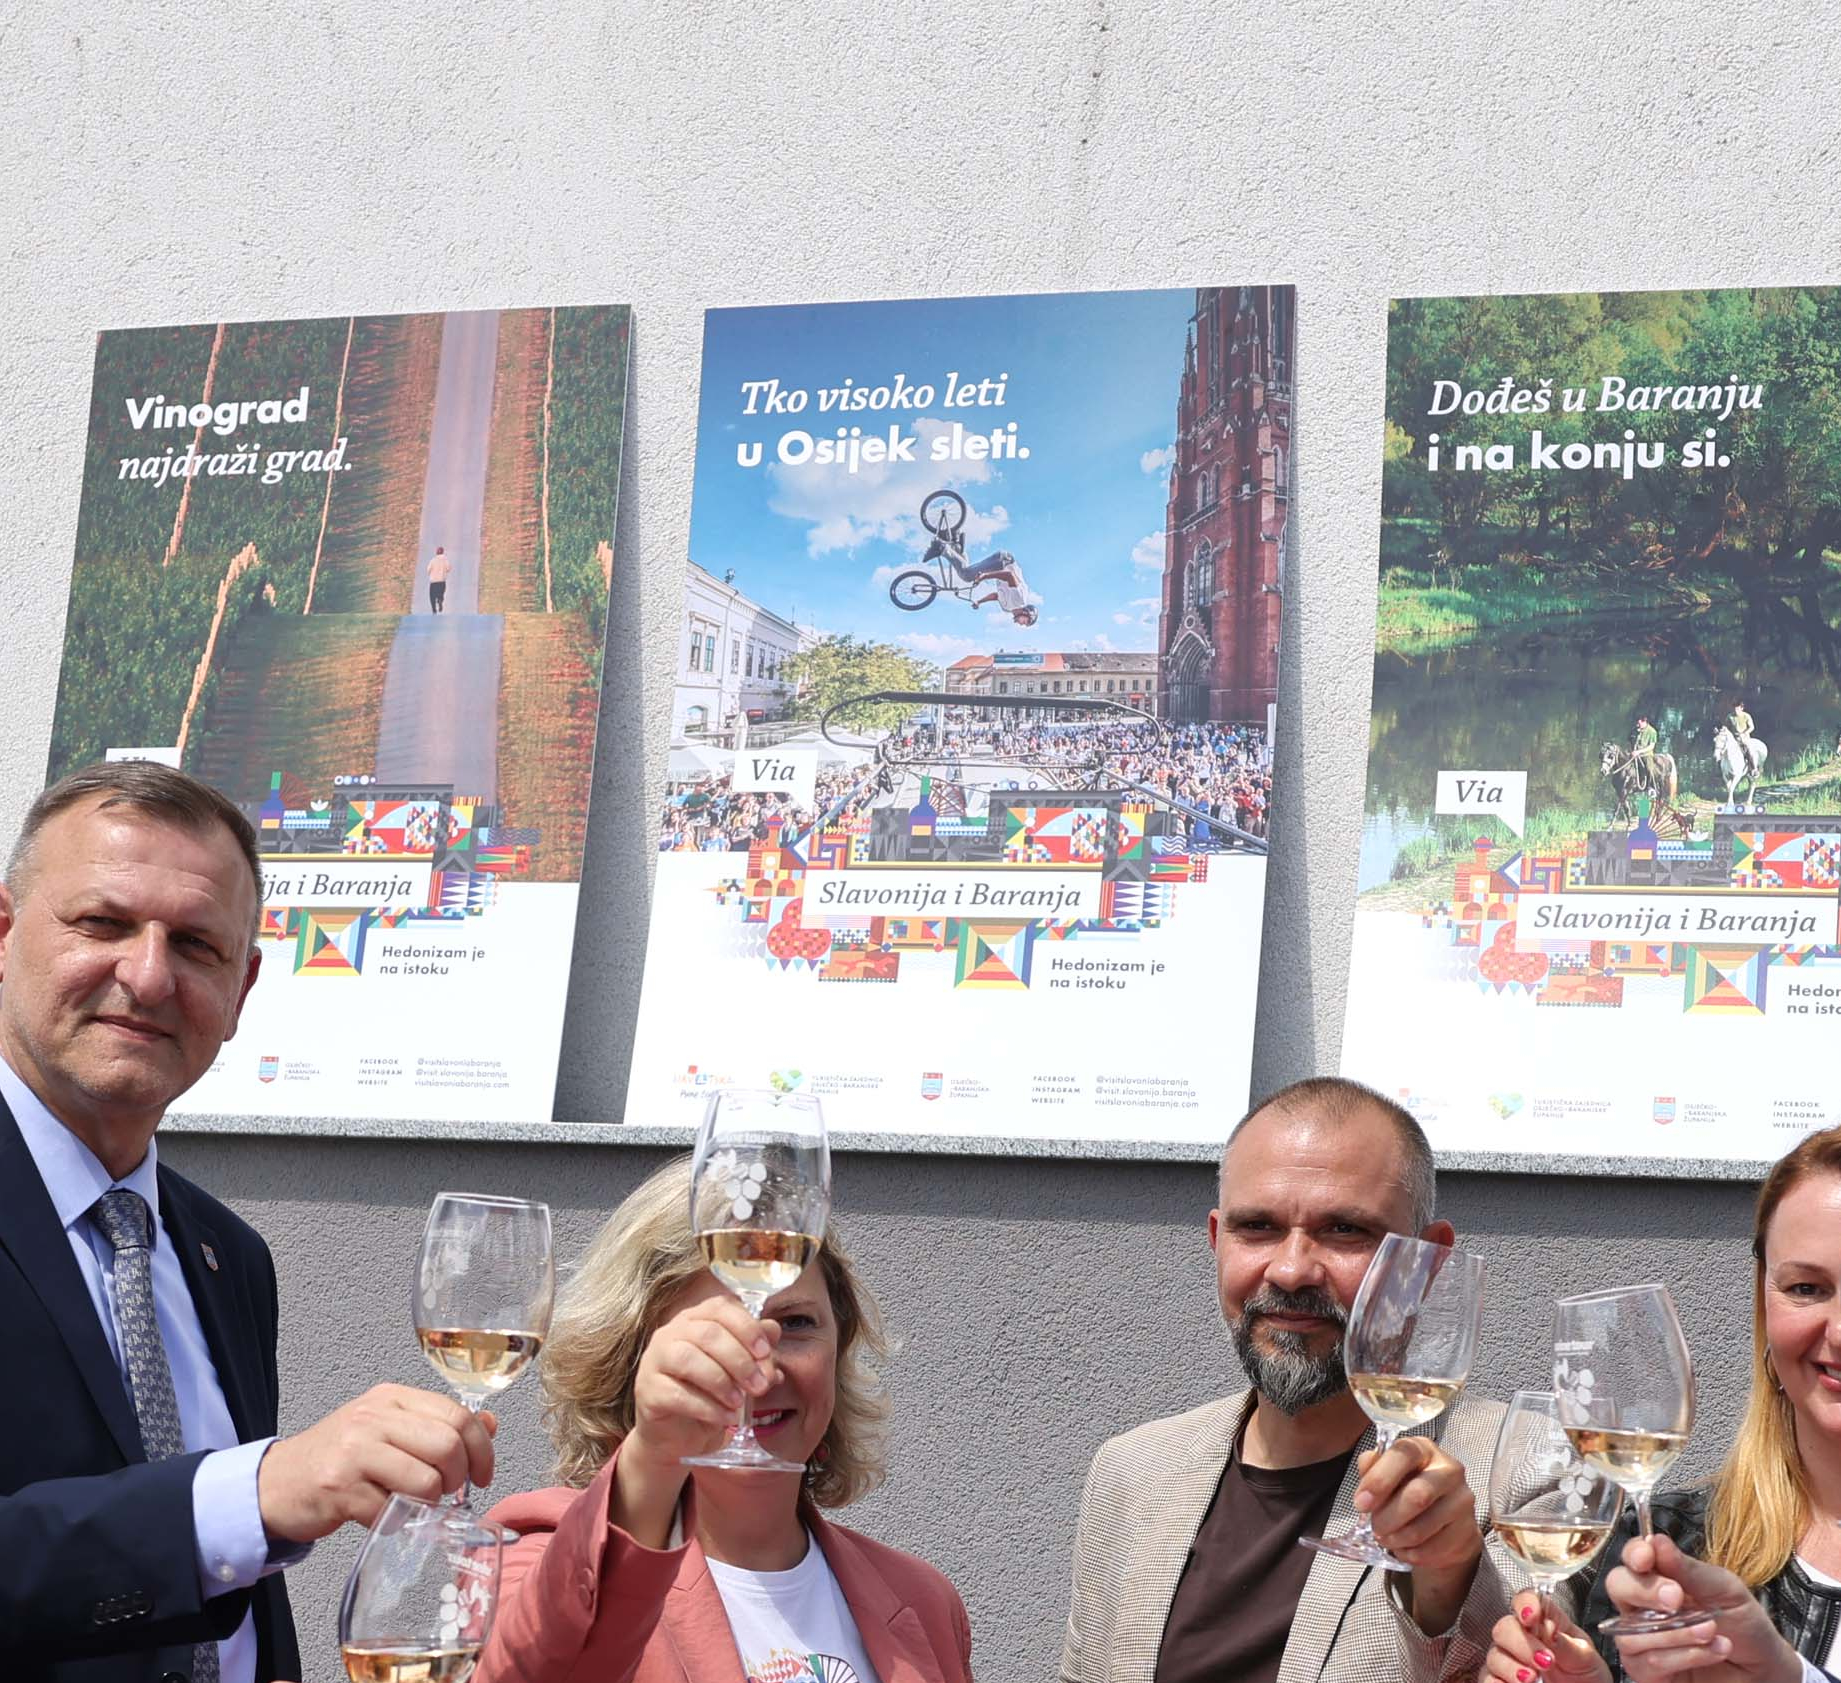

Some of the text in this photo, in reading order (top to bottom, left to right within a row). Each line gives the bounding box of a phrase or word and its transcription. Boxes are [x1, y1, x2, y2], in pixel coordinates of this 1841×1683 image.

[741, 372, 1008, 414] Tko visoko leti
[1427, 374, 1763, 421] Dođeš u Baranju
[125, 387, 308, 435] Vinograd
[737, 422, 1029, 474] u Osijek sleti.
[1428, 428, 1731, 479] i na konju si.
[118, 439, 353, 488] najdraži grad.
[751, 759, 796, 782] Via
[1455, 780, 1503, 804] Via
[297, 875, 307, 895] i
[311, 874, 411, 902] Baranja
[819, 881, 1081, 913] Slavonija i Baranja
[1534, 906, 1817, 939] Slavonija i Baranja
[380, 963, 449, 974] na istoku
[382, 946, 485, 962] Hedonizam je
[1052, 958, 1165, 976] Hedonizam je
[1050, 976, 1126, 990] na istoku
[1787, 1005, 1808, 1015] na
